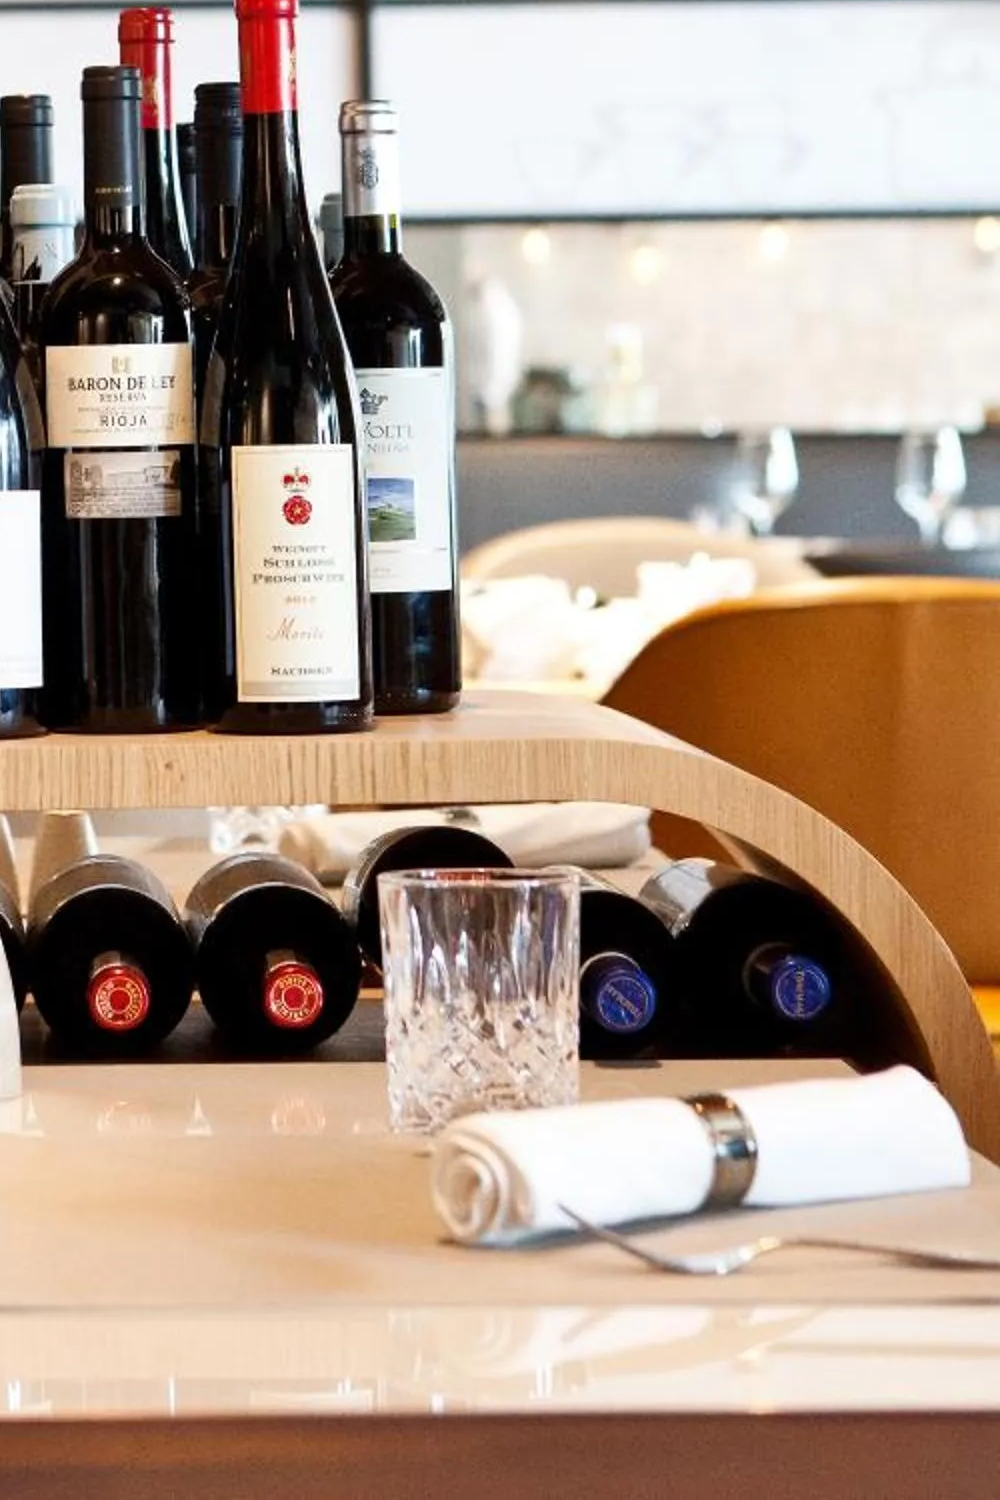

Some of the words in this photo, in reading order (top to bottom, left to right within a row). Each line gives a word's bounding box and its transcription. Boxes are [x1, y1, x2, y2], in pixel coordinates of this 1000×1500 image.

[68, 377, 121, 391] BARON
[127, 376, 147, 389] DE
[100, 415, 147, 427] RIOJA
